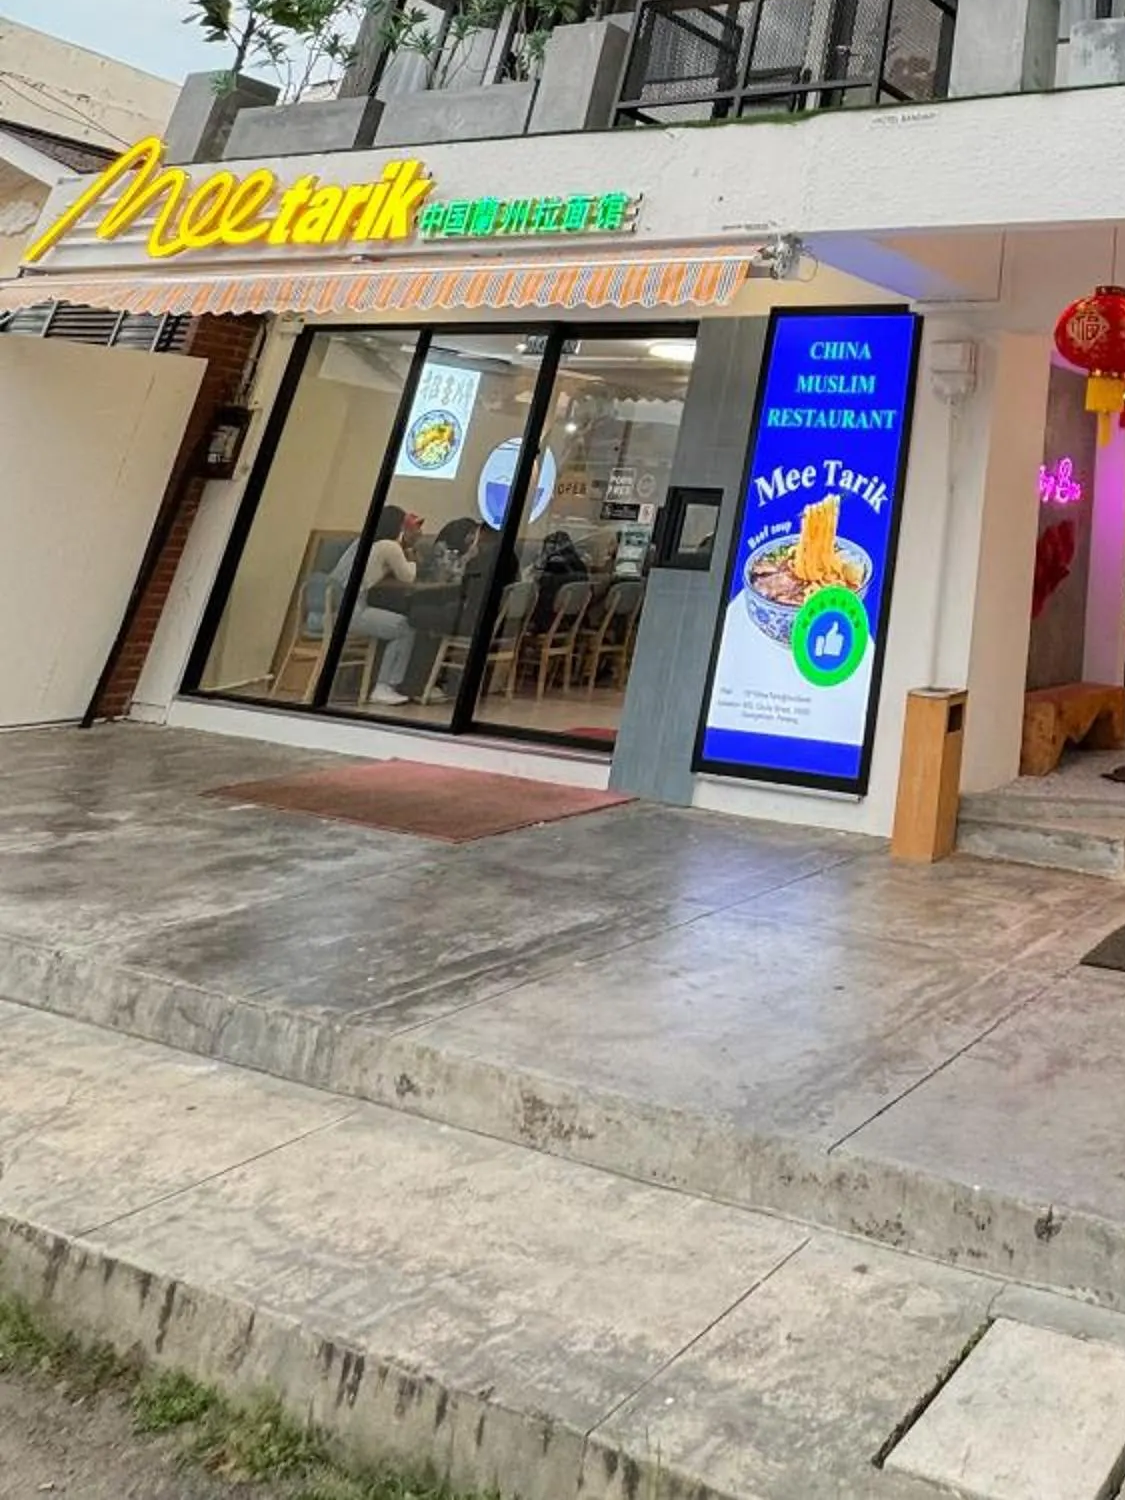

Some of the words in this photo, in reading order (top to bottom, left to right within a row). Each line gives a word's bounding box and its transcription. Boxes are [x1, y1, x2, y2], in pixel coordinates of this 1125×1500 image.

[24, 135, 276, 261] Mee
[268, 157, 433, 245] tarik
[809, 340, 872, 361] CHINA
[795, 374, 876, 395] MUSLIM
[766, 407, 897, 430] RESTAURANT
[754, 465, 817, 508] Mee
[823, 459, 889, 514] Tarik
